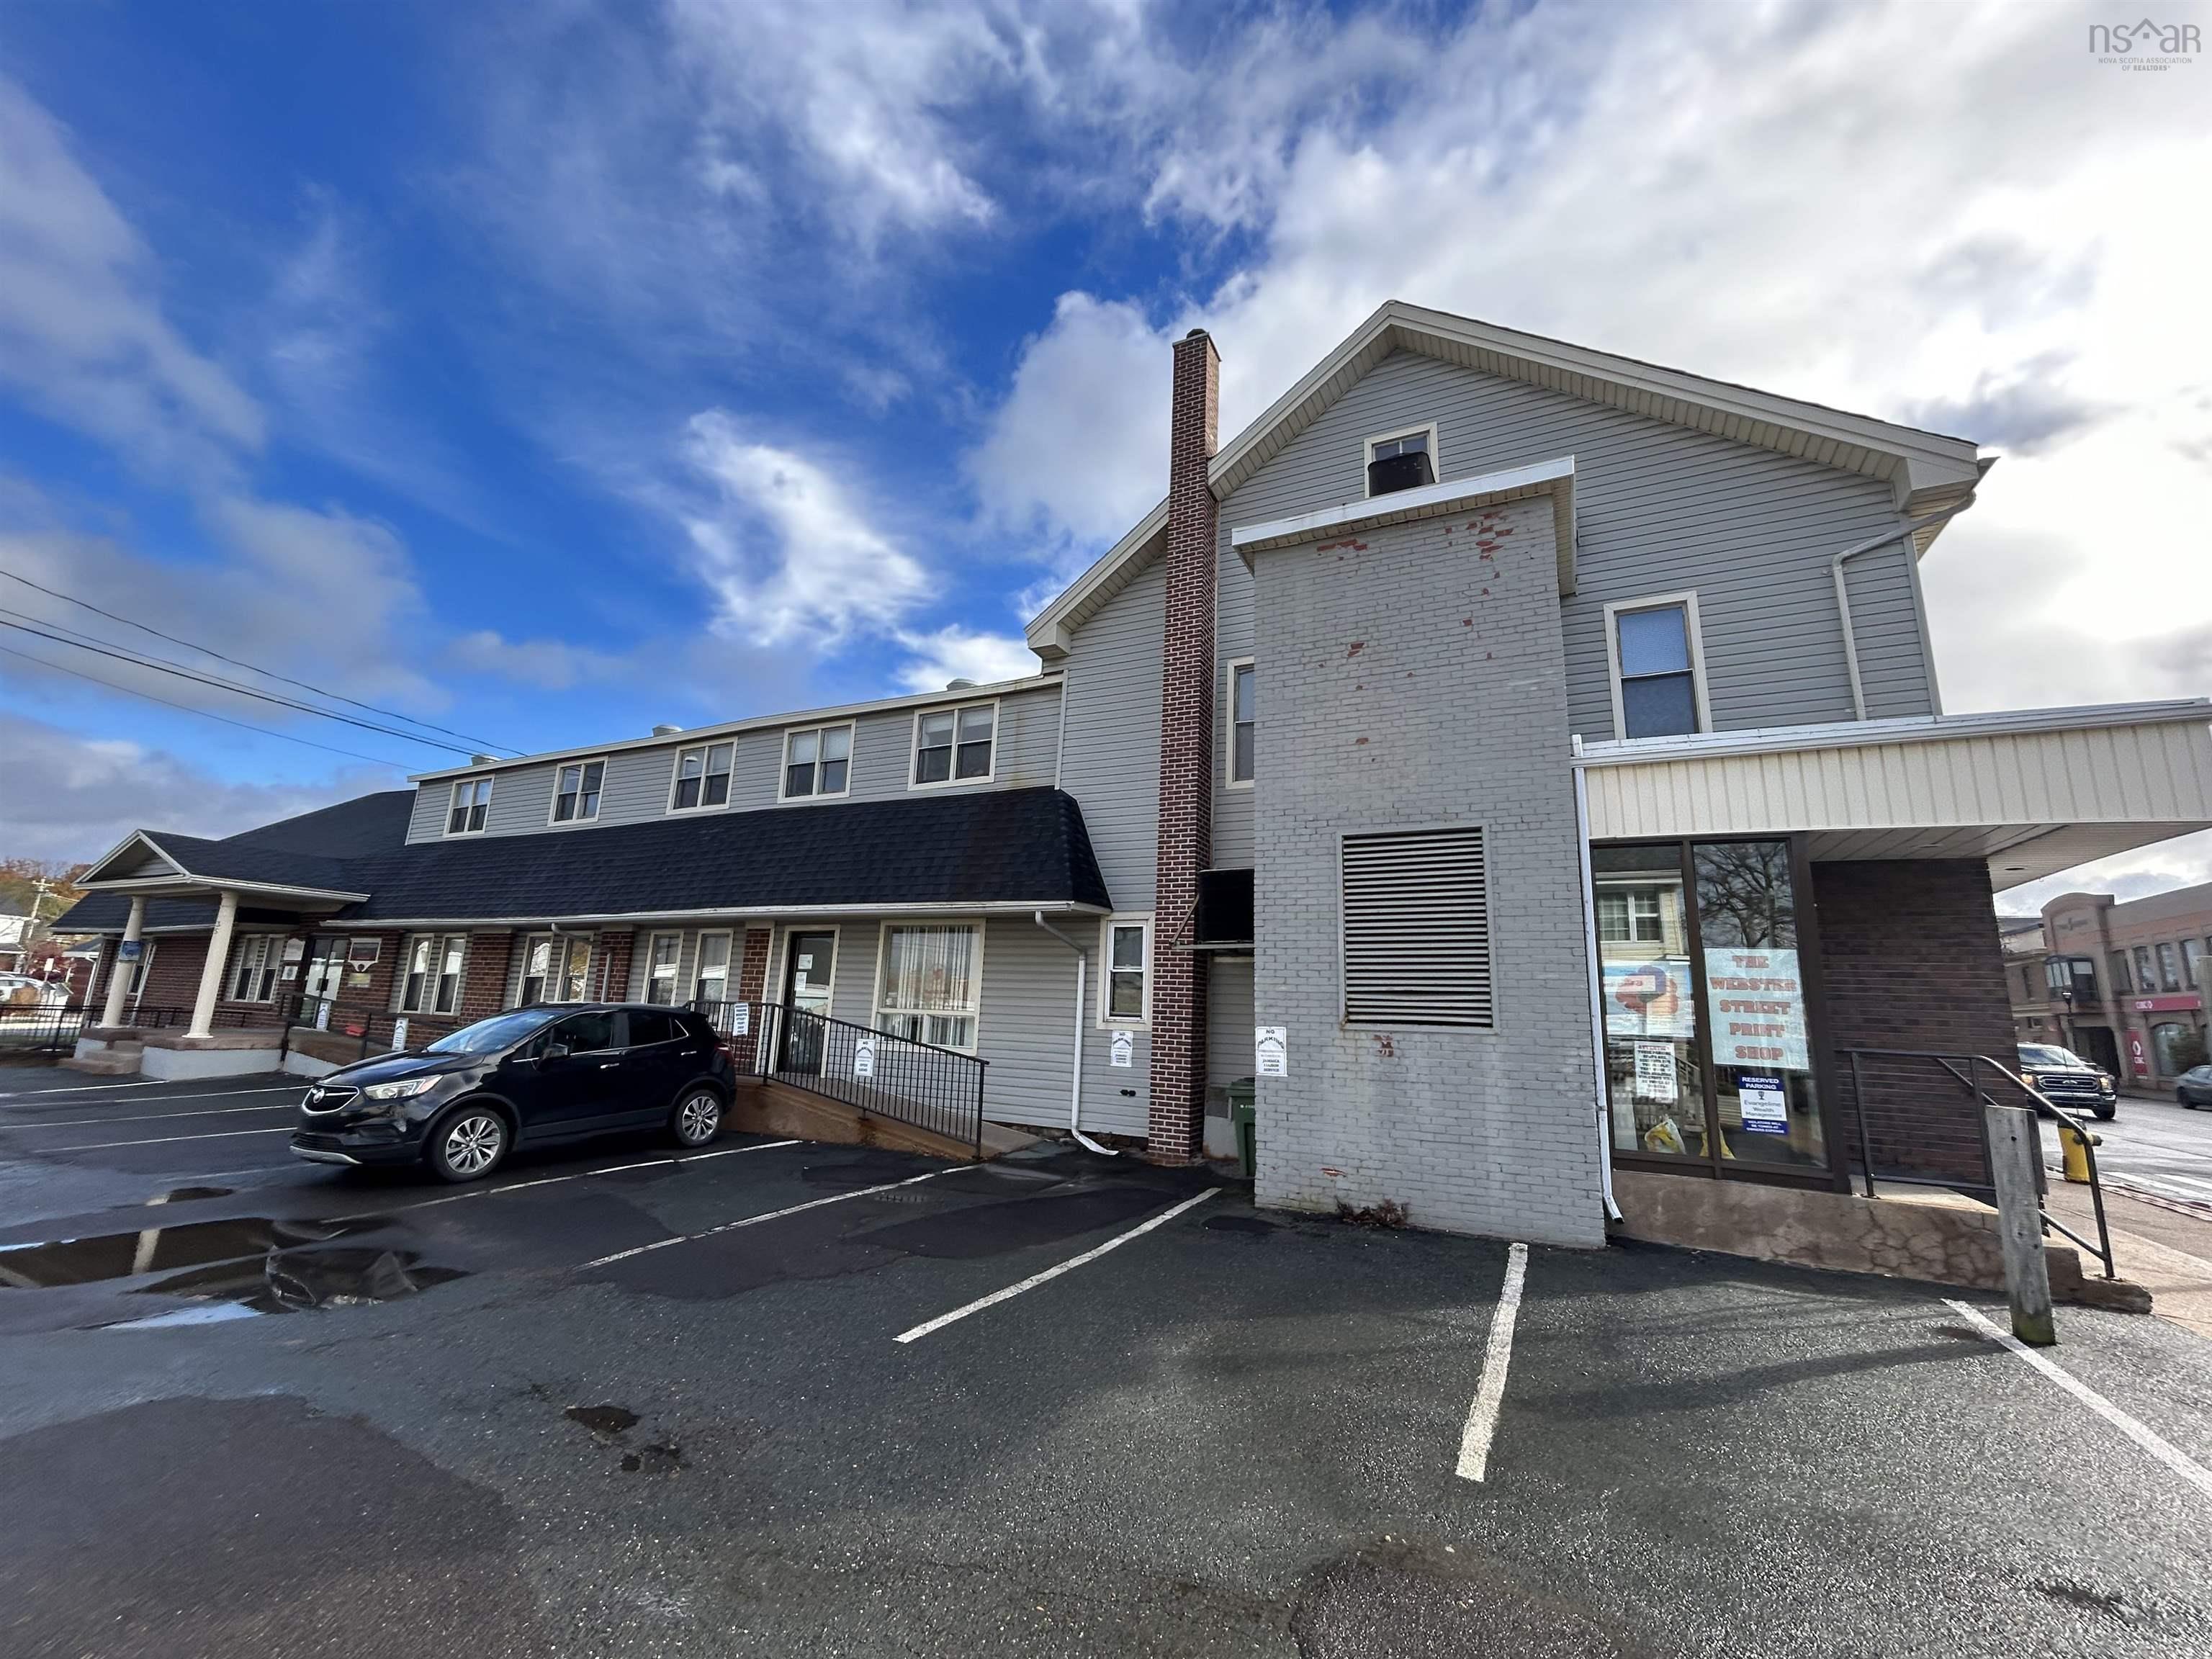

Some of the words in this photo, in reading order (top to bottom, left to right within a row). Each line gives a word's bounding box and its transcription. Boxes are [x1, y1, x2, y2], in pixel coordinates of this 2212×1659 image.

[1732, 956, 1769, 968] THE
[1709, 977, 1797, 992] WEBSTER
[1719, 999, 1791, 1015] STREET
[1730, 1022, 1786, 1037] PRINT
[1257, 1037, 1284, 1049] PARKING
[1735, 1046, 1784, 1060] SHOP
